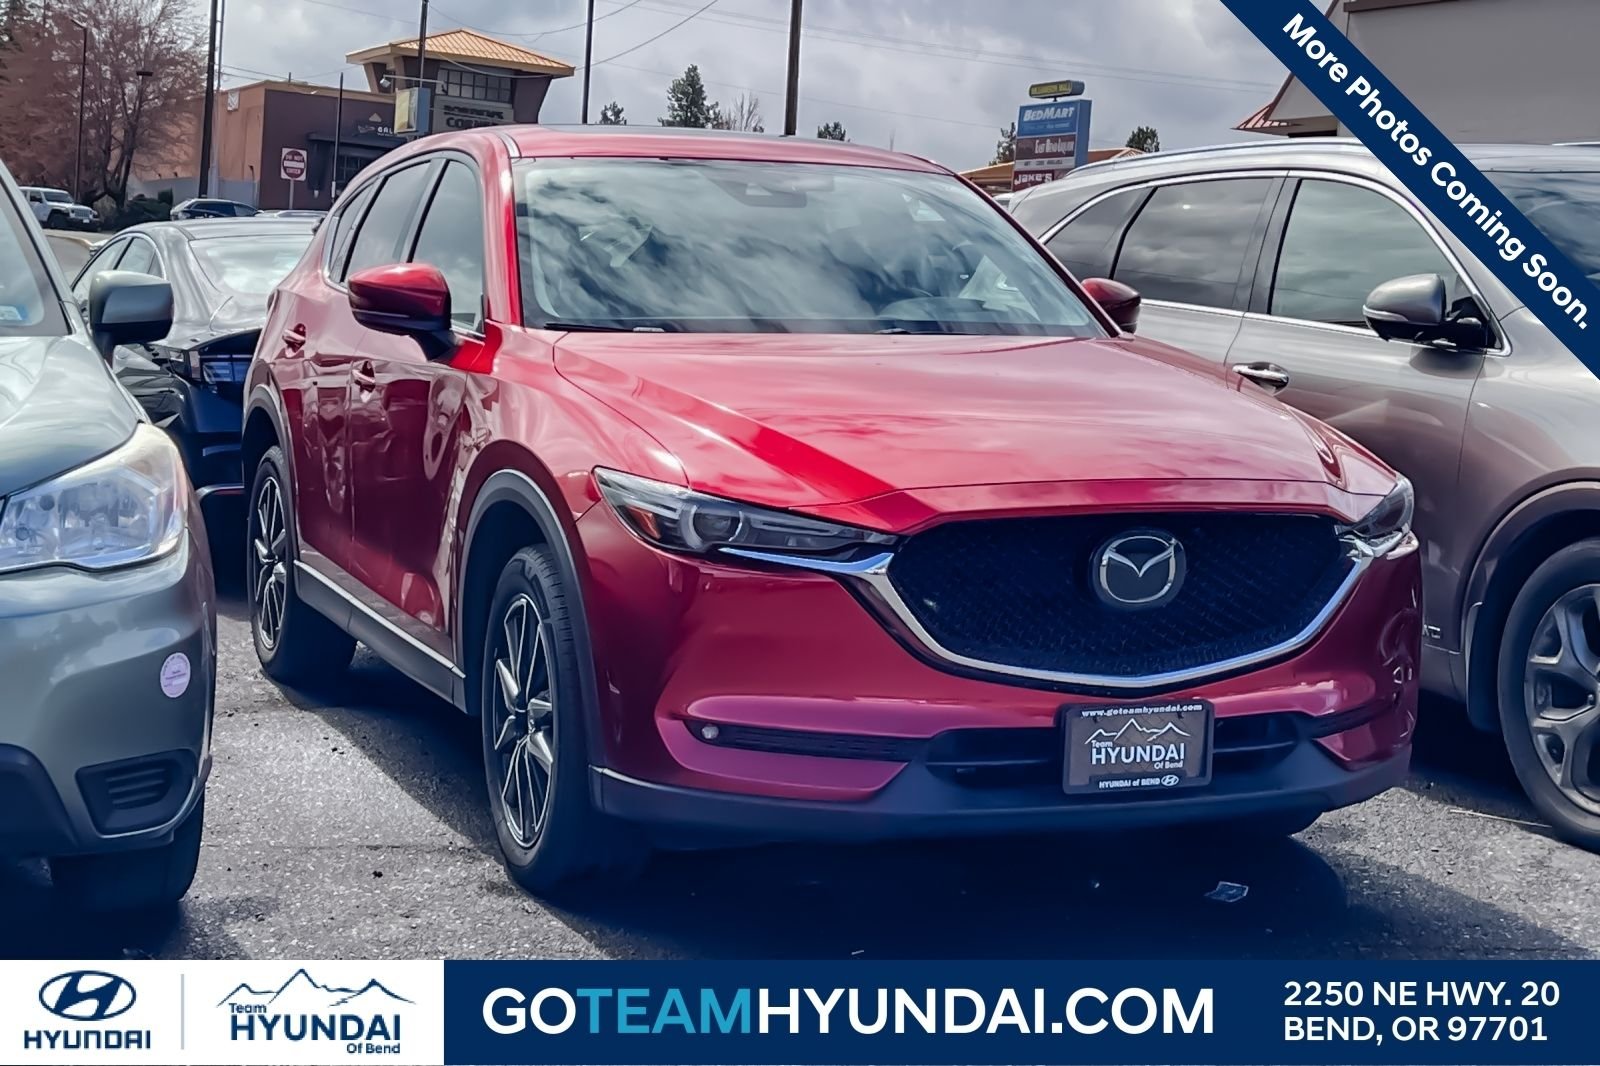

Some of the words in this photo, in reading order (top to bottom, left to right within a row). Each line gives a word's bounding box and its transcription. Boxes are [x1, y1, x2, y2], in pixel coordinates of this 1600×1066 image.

[1081, 704, 1203, 718] www.goteamhyundai.com
[1091, 740, 1113, 748] Team
[1091, 743, 1185, 765] HYUNDAI
[1154, 761, 1164, 770] Of
[1165, 761, 1183, 769] Bend
[1099, 779, 1132, 789] HYUNDAI
[1132, 779, 1140, 787] of
[1141, 777, 1160, 786] BEND
